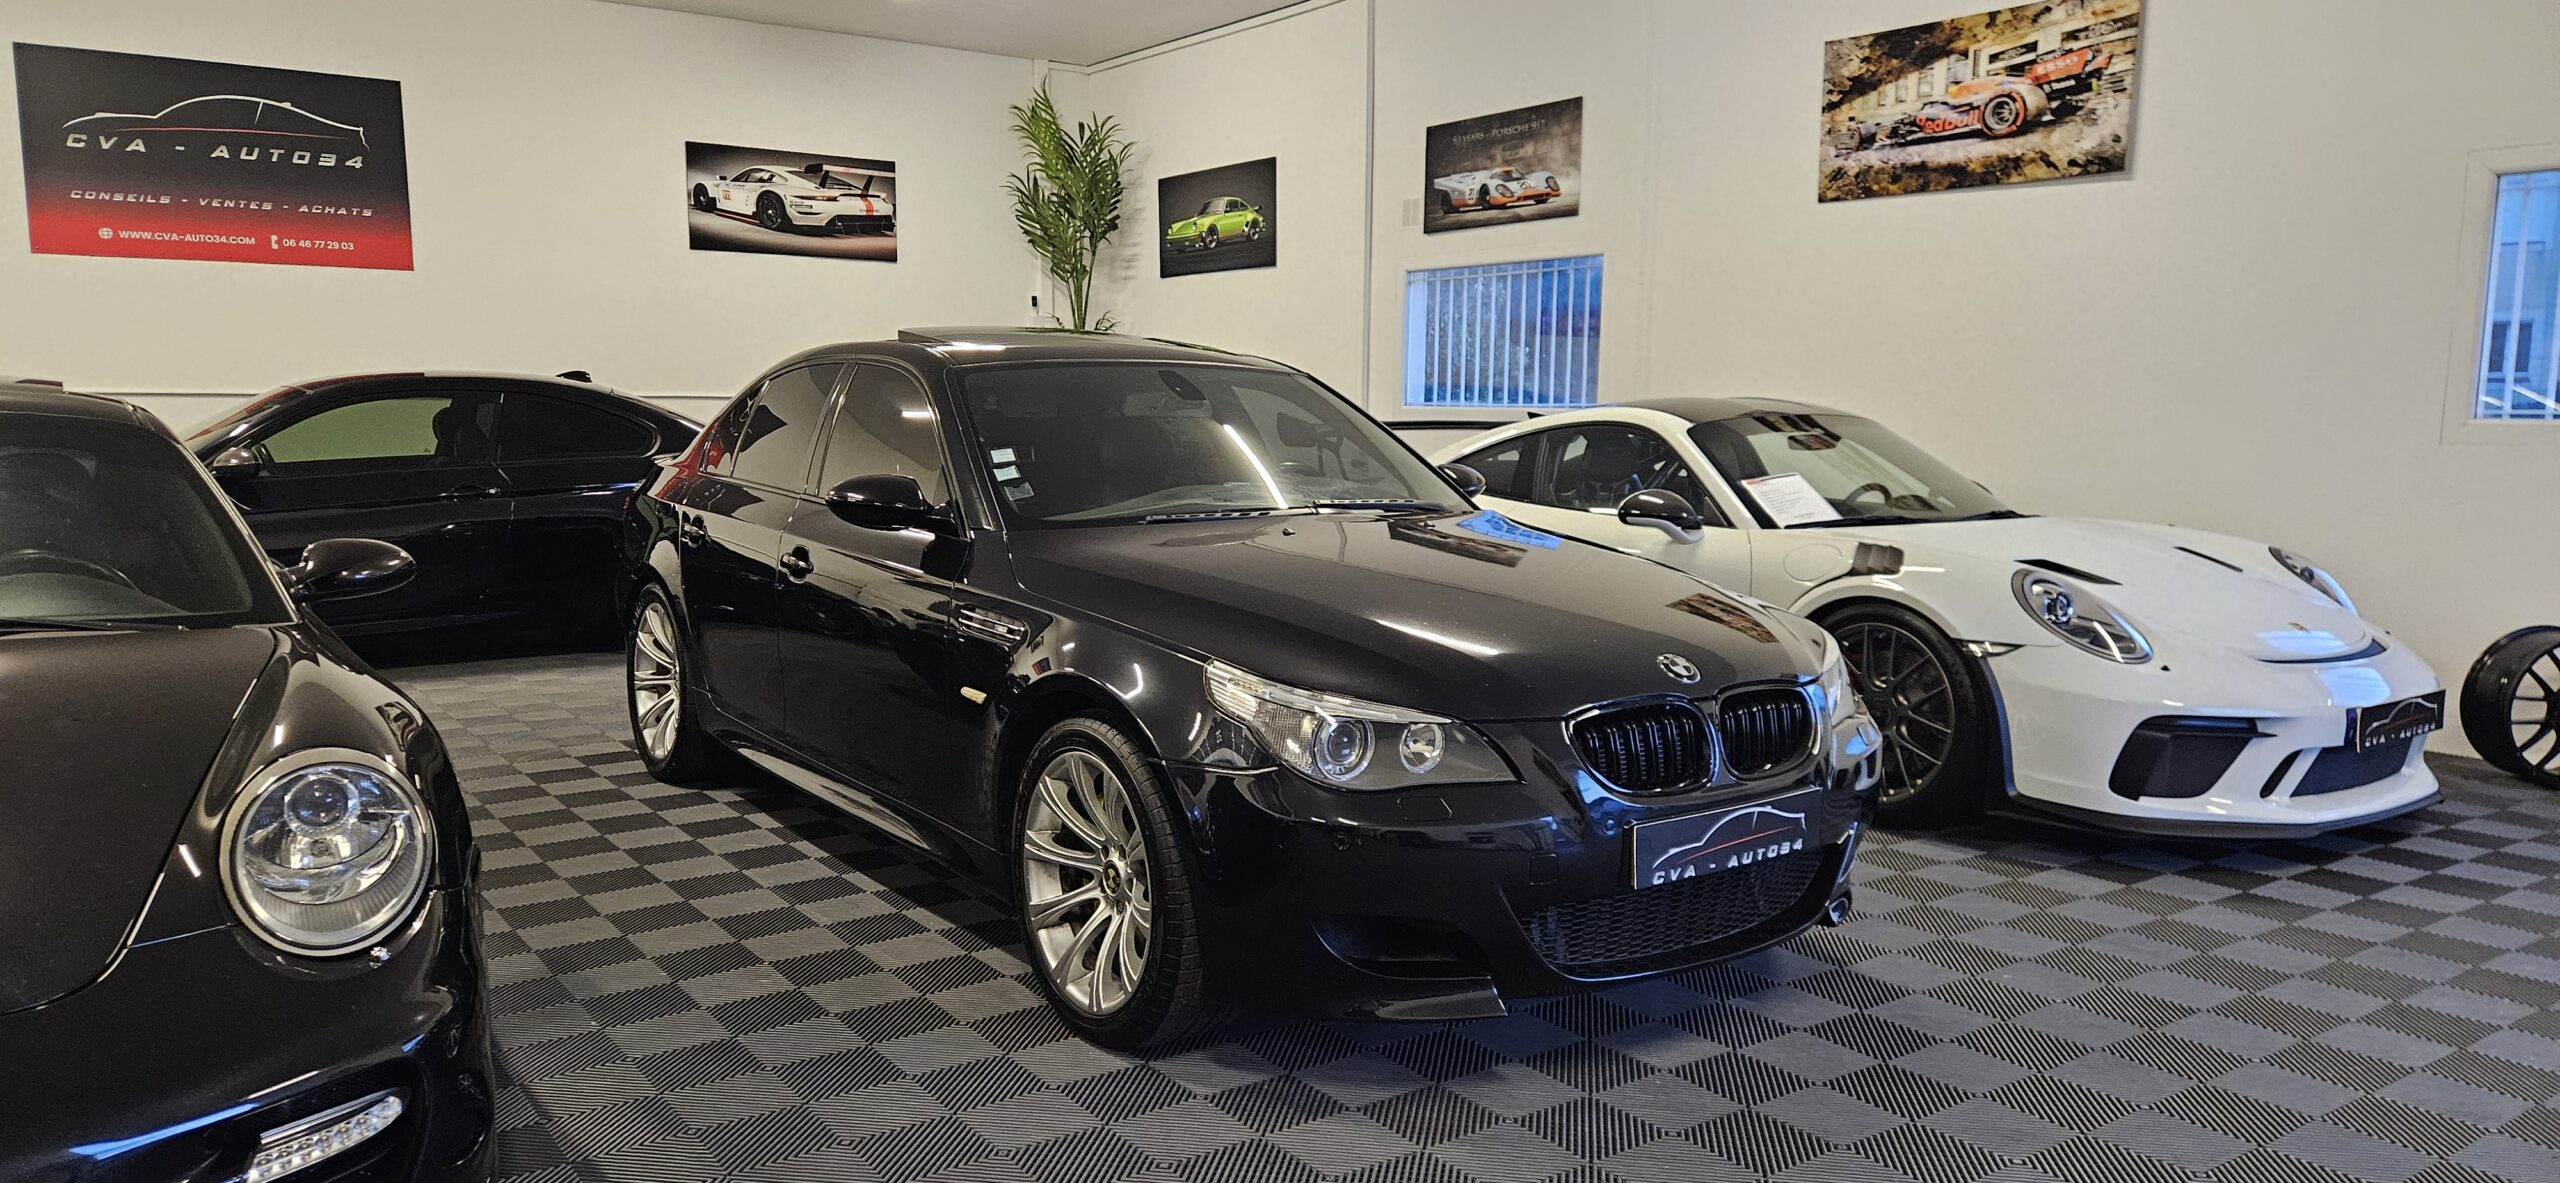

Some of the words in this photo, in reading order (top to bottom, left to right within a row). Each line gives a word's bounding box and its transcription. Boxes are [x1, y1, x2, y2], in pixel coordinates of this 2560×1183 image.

[1462, 132, 1484, 143] YEARS
[1491, 123, 1529, 137] PORSCHE
[66, 133, 146, 152] CVA
[210, 145, 363, 169] AUTO34
[70, 190, 171, 204] CONSEILS
[199, 198, 273, 210] VENTES
[298, 205, 373, 217] ACHATS
[118, 230, 255, 245] WWW.CVA-AUTO34.COM
[283, 239, 296, 247] 06
[298, 240, 312, 248] 46
[313, 240, 326, 248] 77
[326, 241, 340, 249] 29
[341, 242, 354, 250] 03
[2365, 735, 2385, 747] CVA
[1652, 864, 1696, 885] CVA
[1728, 838, 1803, 868] AUTO34
